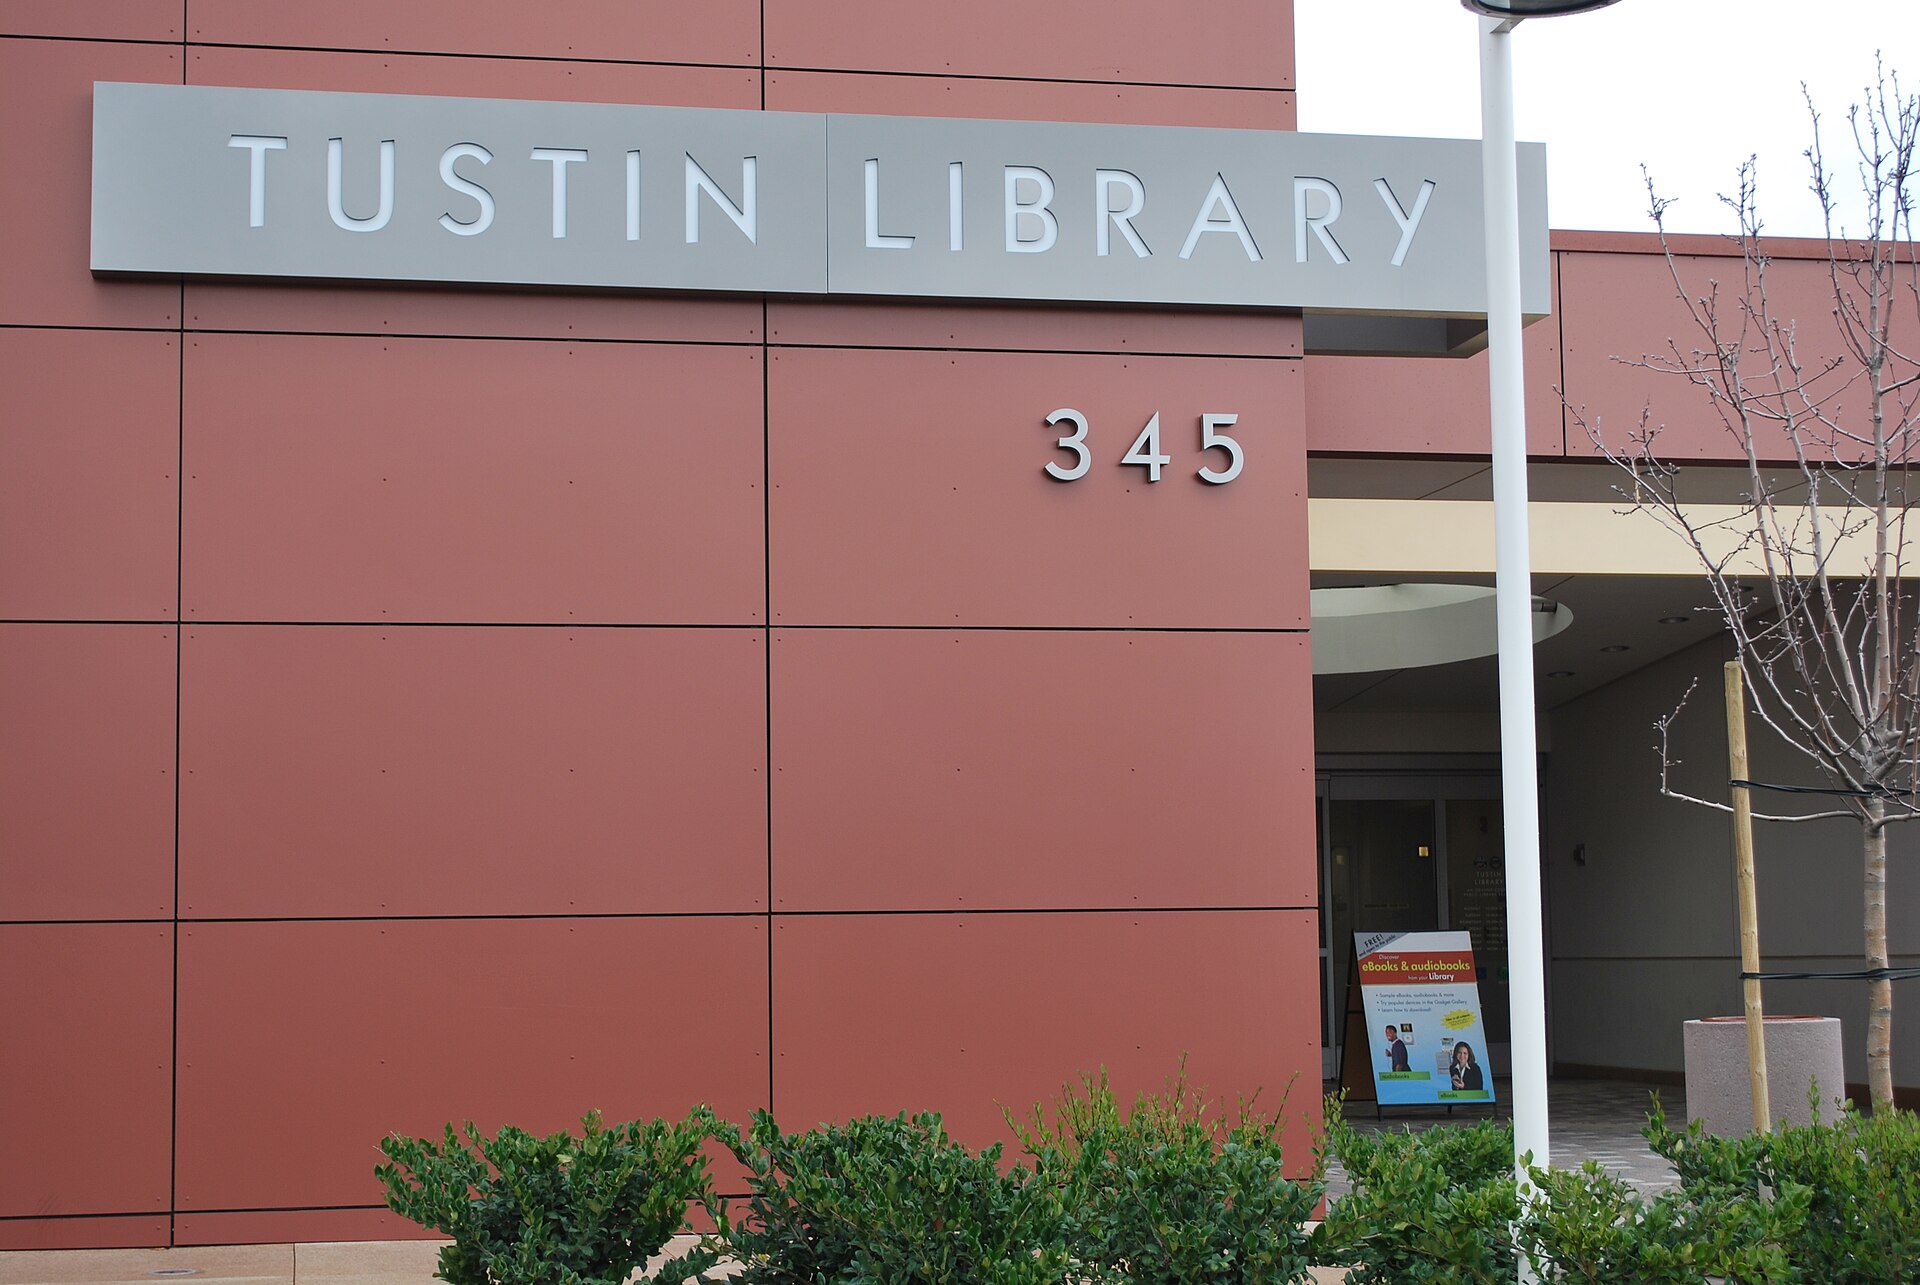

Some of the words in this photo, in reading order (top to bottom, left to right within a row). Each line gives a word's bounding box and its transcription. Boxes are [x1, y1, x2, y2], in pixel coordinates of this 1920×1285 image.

[227, 133, 757, 246] TUSTIN
[864, 157, 1436, 267] LIBRARY
[1042, 407, 1245, 486] 345
[1364, 933, 1384, 948] FREE!
[1362, 961, 1399, 971] eBooks
[1401, 961, 1409, 971] &
[1411, 960, 1471, 971] audiobooks
[1428, 972, 1455, 982] Library
